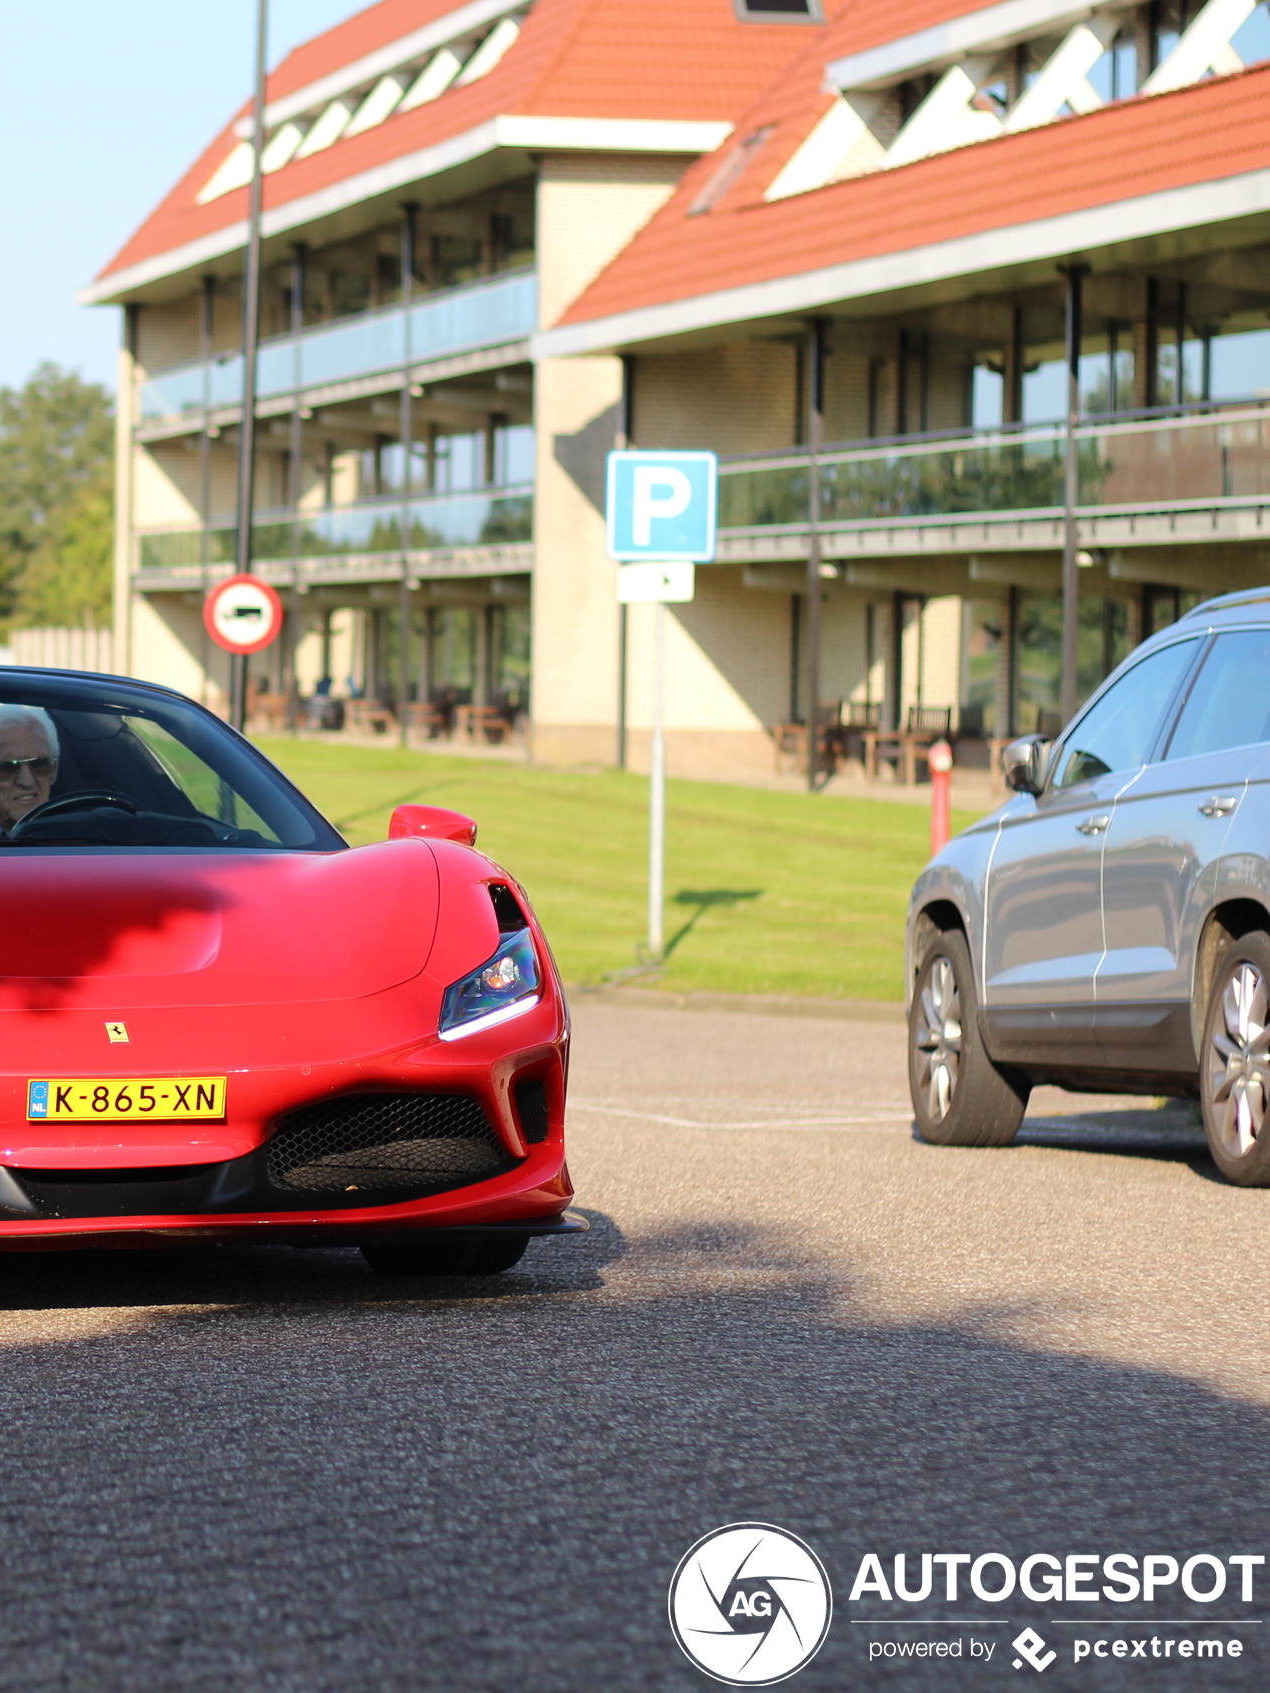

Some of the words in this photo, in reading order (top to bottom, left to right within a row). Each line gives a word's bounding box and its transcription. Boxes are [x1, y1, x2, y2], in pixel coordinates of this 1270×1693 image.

[632, 466, 692, 546] P
[32, 1102, 46, 1112] NL
[55, 1084, 216, 1113] K-865-XN
